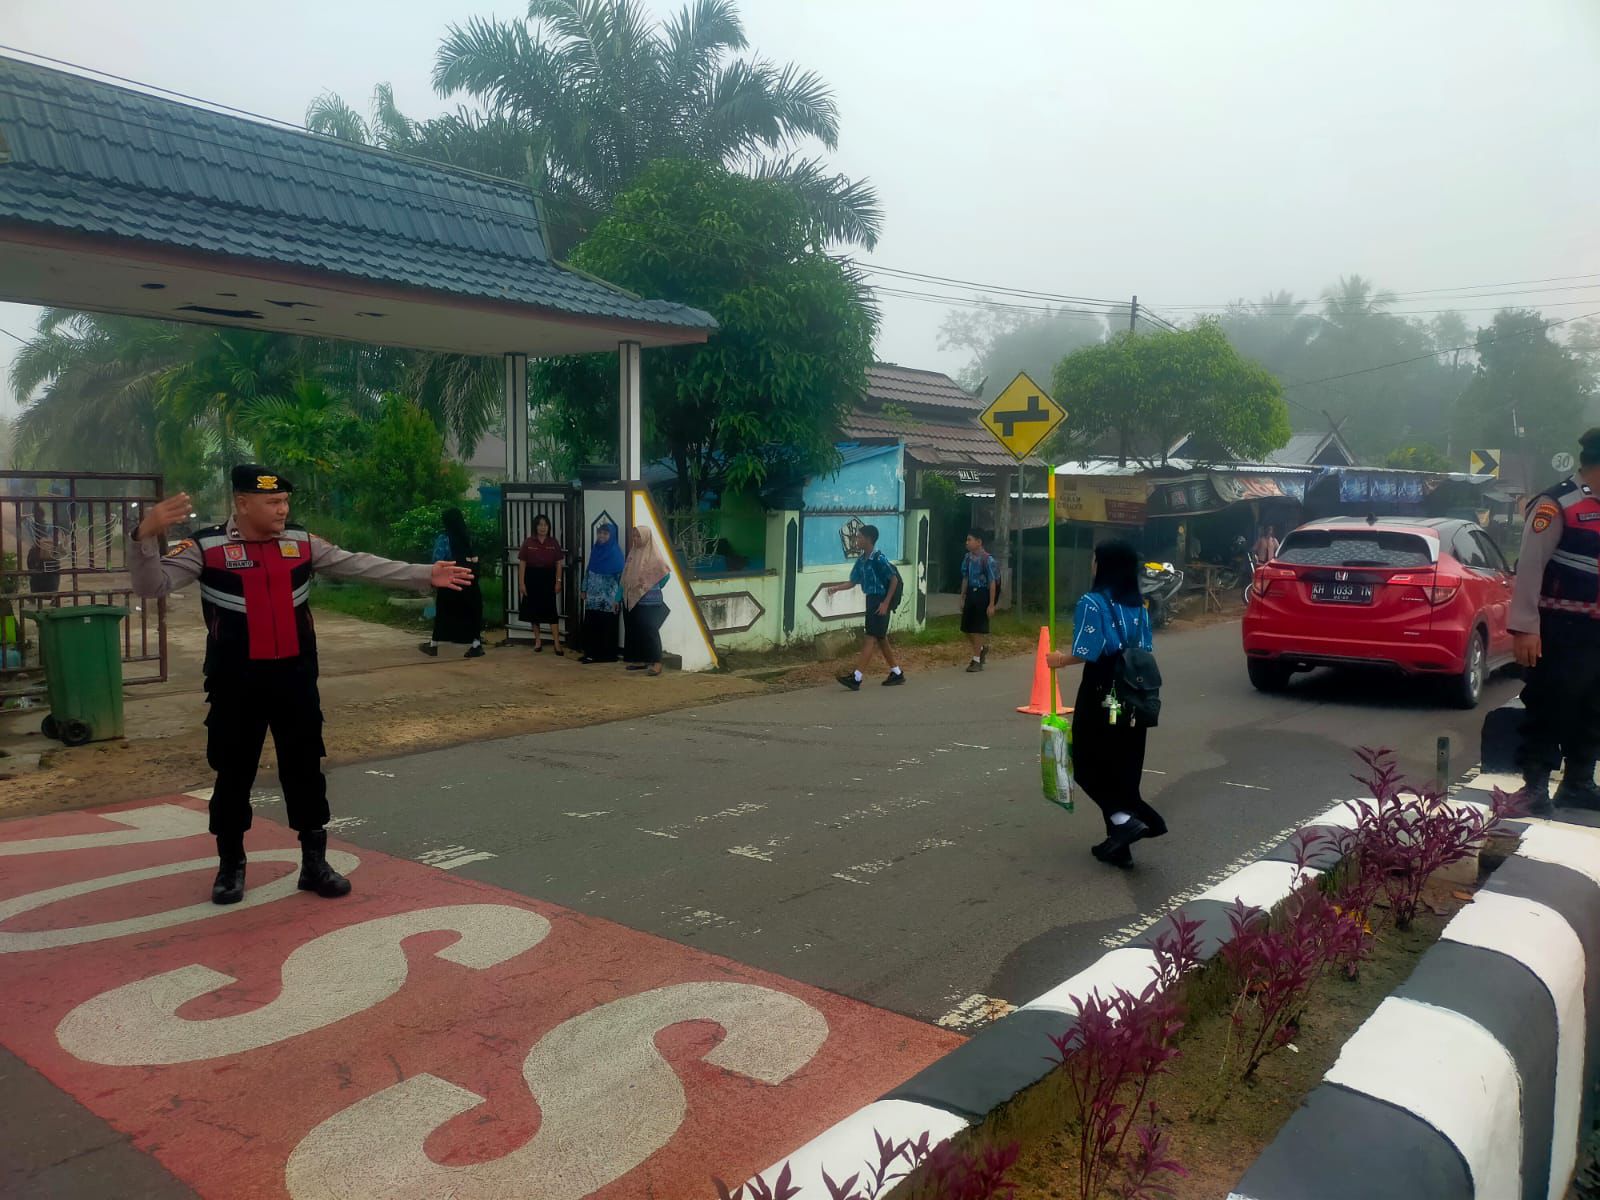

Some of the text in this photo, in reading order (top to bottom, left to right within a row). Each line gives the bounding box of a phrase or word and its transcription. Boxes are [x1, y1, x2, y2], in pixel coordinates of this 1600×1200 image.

[1556, 455, 1570, 469] 30
[1312, 583, 1325, 594] KH
[1333, 585, 1353, 596] 1033
